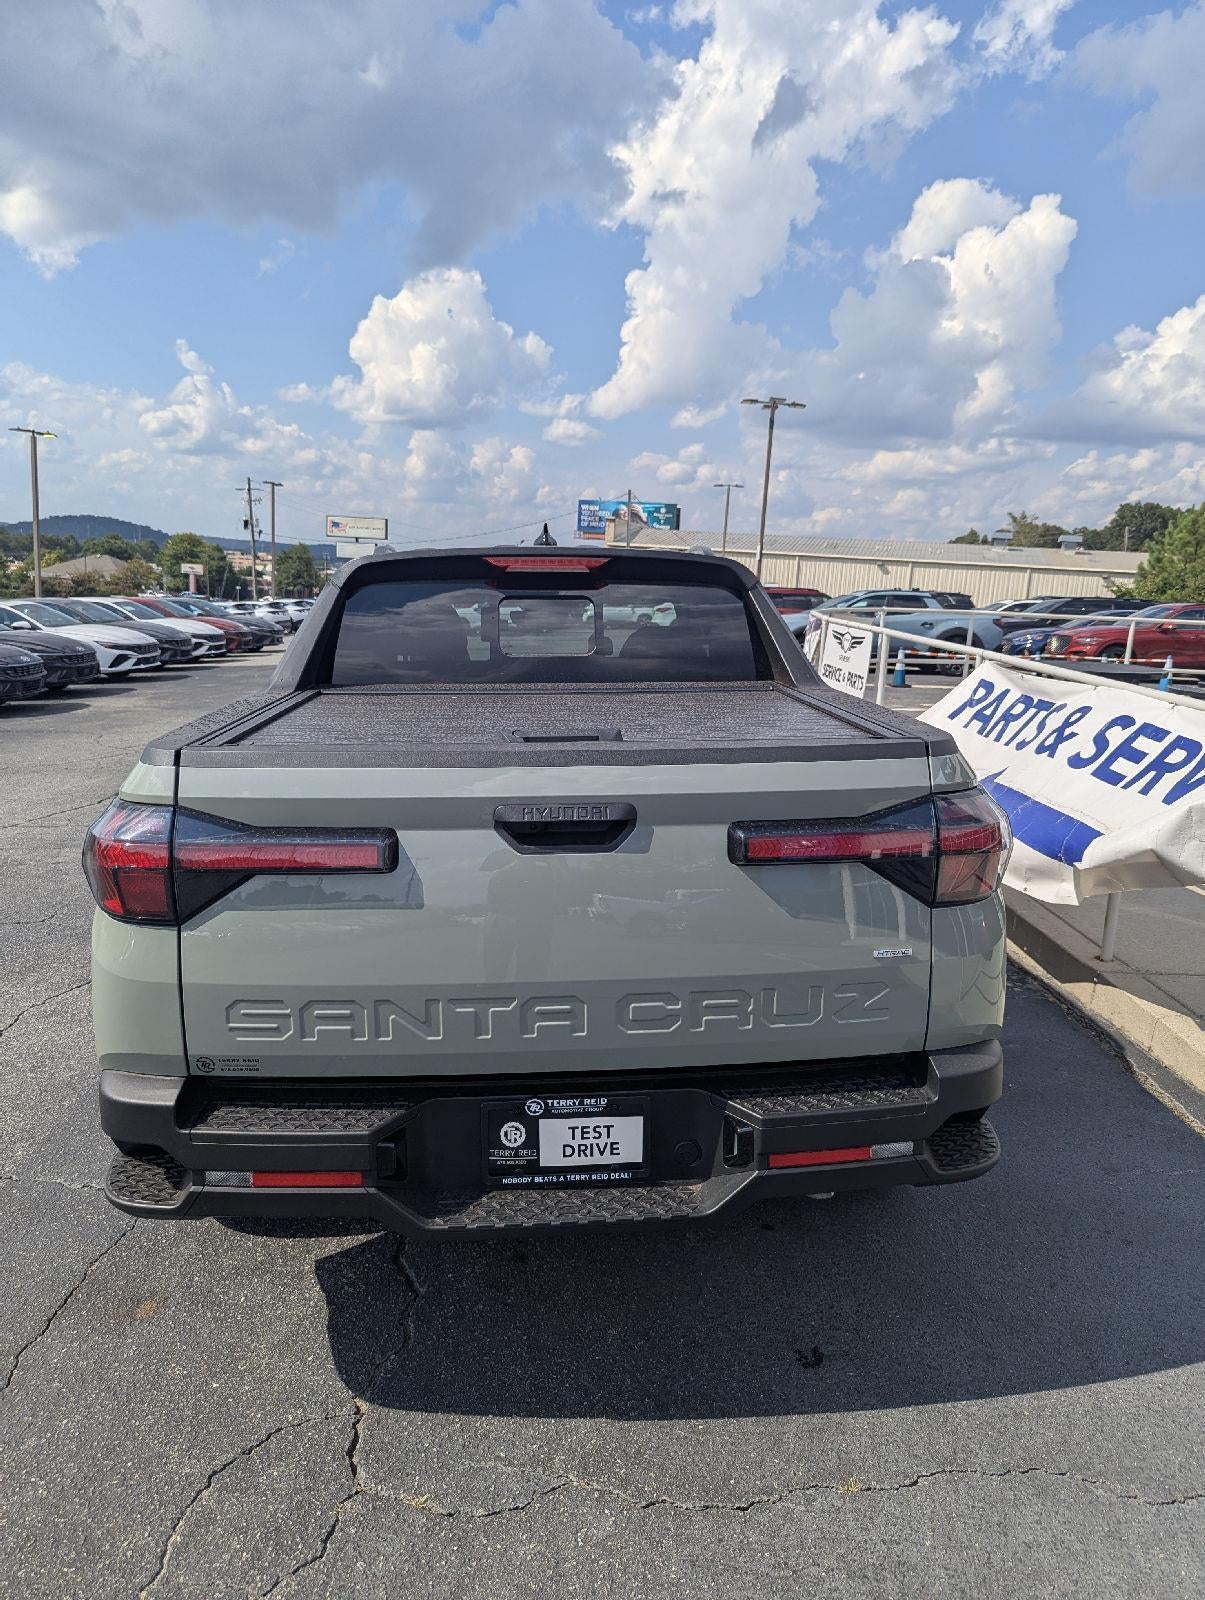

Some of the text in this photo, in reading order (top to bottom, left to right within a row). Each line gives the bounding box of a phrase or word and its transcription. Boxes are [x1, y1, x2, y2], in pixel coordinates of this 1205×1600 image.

[822, 663, 842, 683] SERVICE
[845, 671, 864, 691] PARTS
[521, 806, 610, 821] HYUNDAI
[225, 981, 891, 1041] SANTA CRUZ
[547, 1097, 608, 1107] TERRY REID
[568, 1124, 615, 1141] TEST
[562, 1141, 621, 1158] DRIVE
